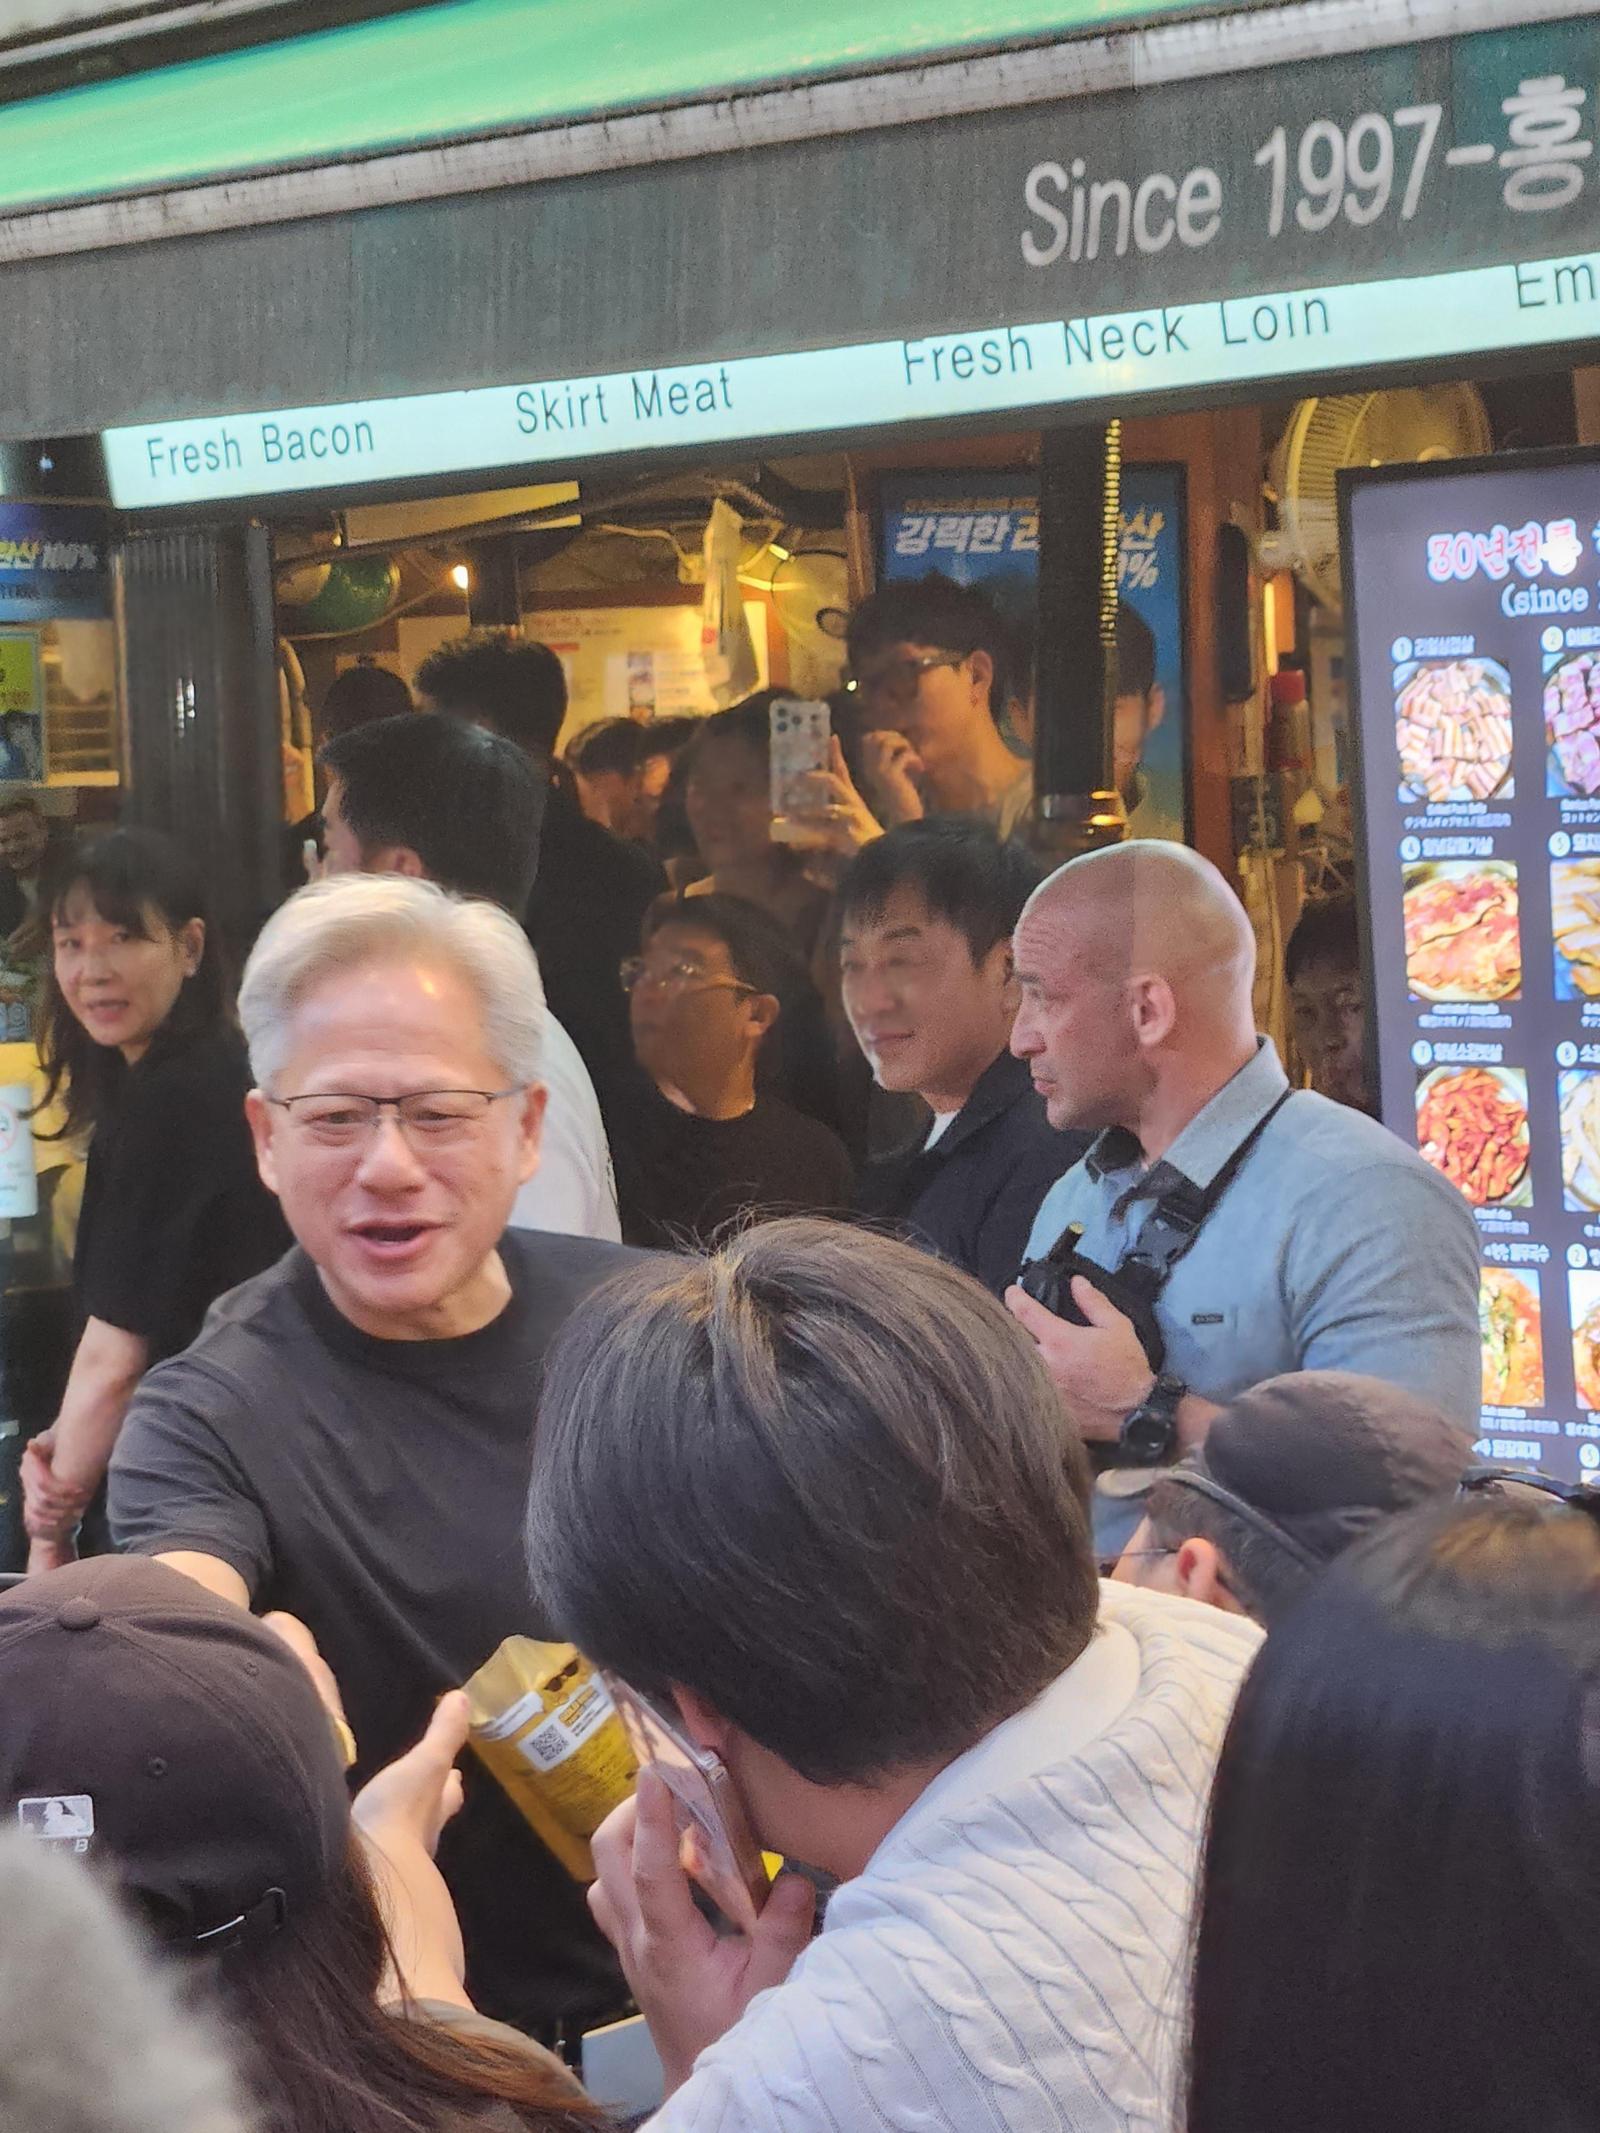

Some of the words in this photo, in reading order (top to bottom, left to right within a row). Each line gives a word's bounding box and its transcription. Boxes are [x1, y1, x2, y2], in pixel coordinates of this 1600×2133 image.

[1021, 158, 1223, 267] Since
[901, 326, 1034, 385] Fresh
[1064, 308, 1190, 365] Neck
[1220, 296, 1332, 346] Loin
[514, 384, 609, 435] Skirt
[632, 366, 734, 421] Meat
[146, 428, 243, 478] Fresh
[261, 418, 376, 464] Bacon
[1501, 583, 1589, 618] (since
